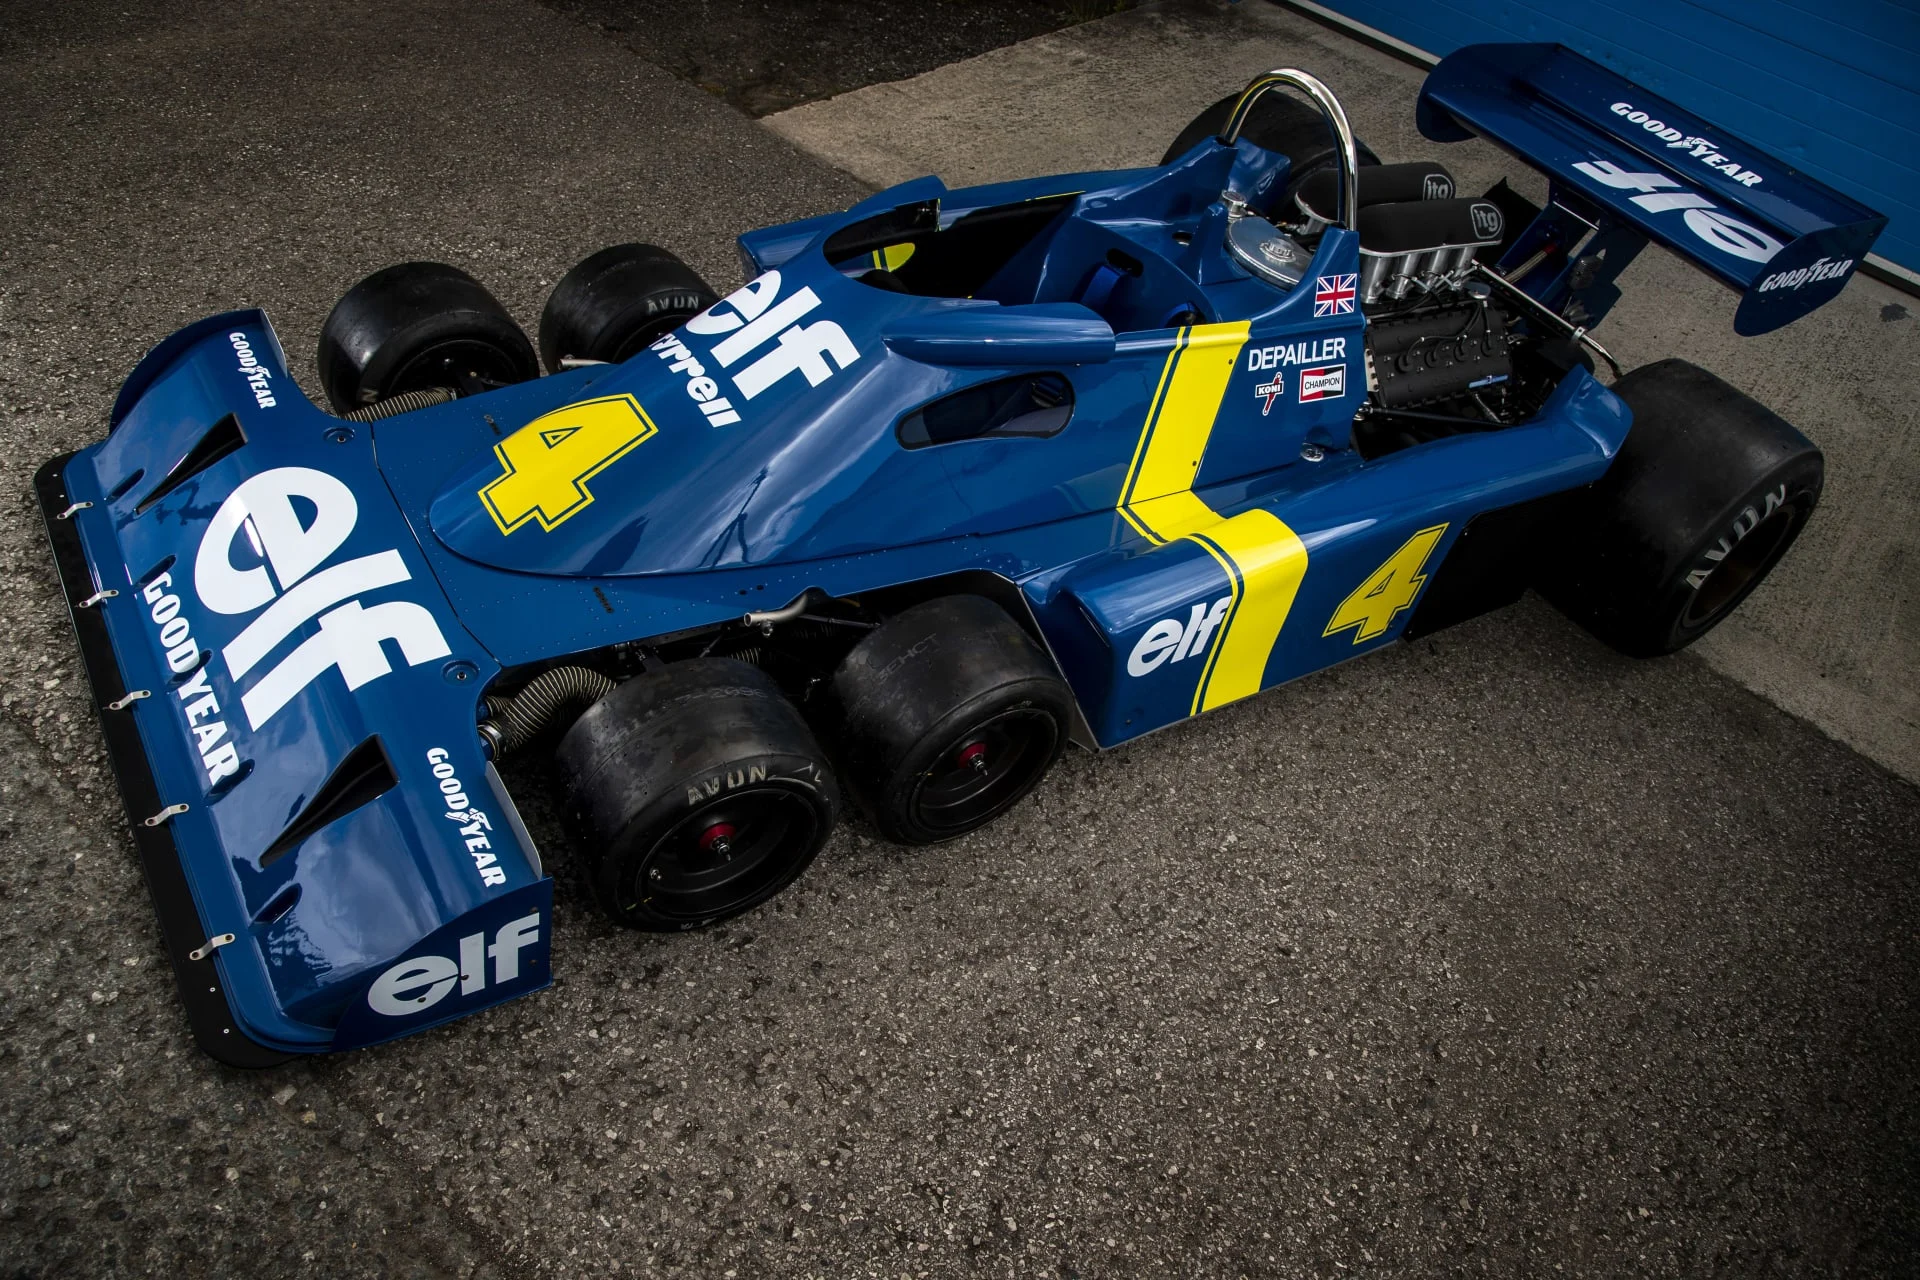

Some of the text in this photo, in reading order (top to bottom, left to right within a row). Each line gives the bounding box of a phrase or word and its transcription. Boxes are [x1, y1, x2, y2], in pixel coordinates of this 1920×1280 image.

[1610, 102, 1763, 187] GOODYEAR
[1474, 208, 1499, 232] itg
[1572, 160, 1785, 263] elf
[1758, 257, 1853, 293] GOODYEAR
[229, 332, 277, 410] GOODYEAR
[686, 270, 861, 400] elf
[1248, 338, 1346, 371] DEPAILLER
[1258, 384, 1281, 395] KONI
[1304, 378, 1341, 390] CHAMPION
[477, 392, 659, 536] 4
[194, 466, 452, 732] elf
[1322, 522, 1450, 645] 4
[1127, 595, 1232, 677] elf
[426, 747, 507, 888] GOODYEAR
[367, 912, 540, 1016] elf
